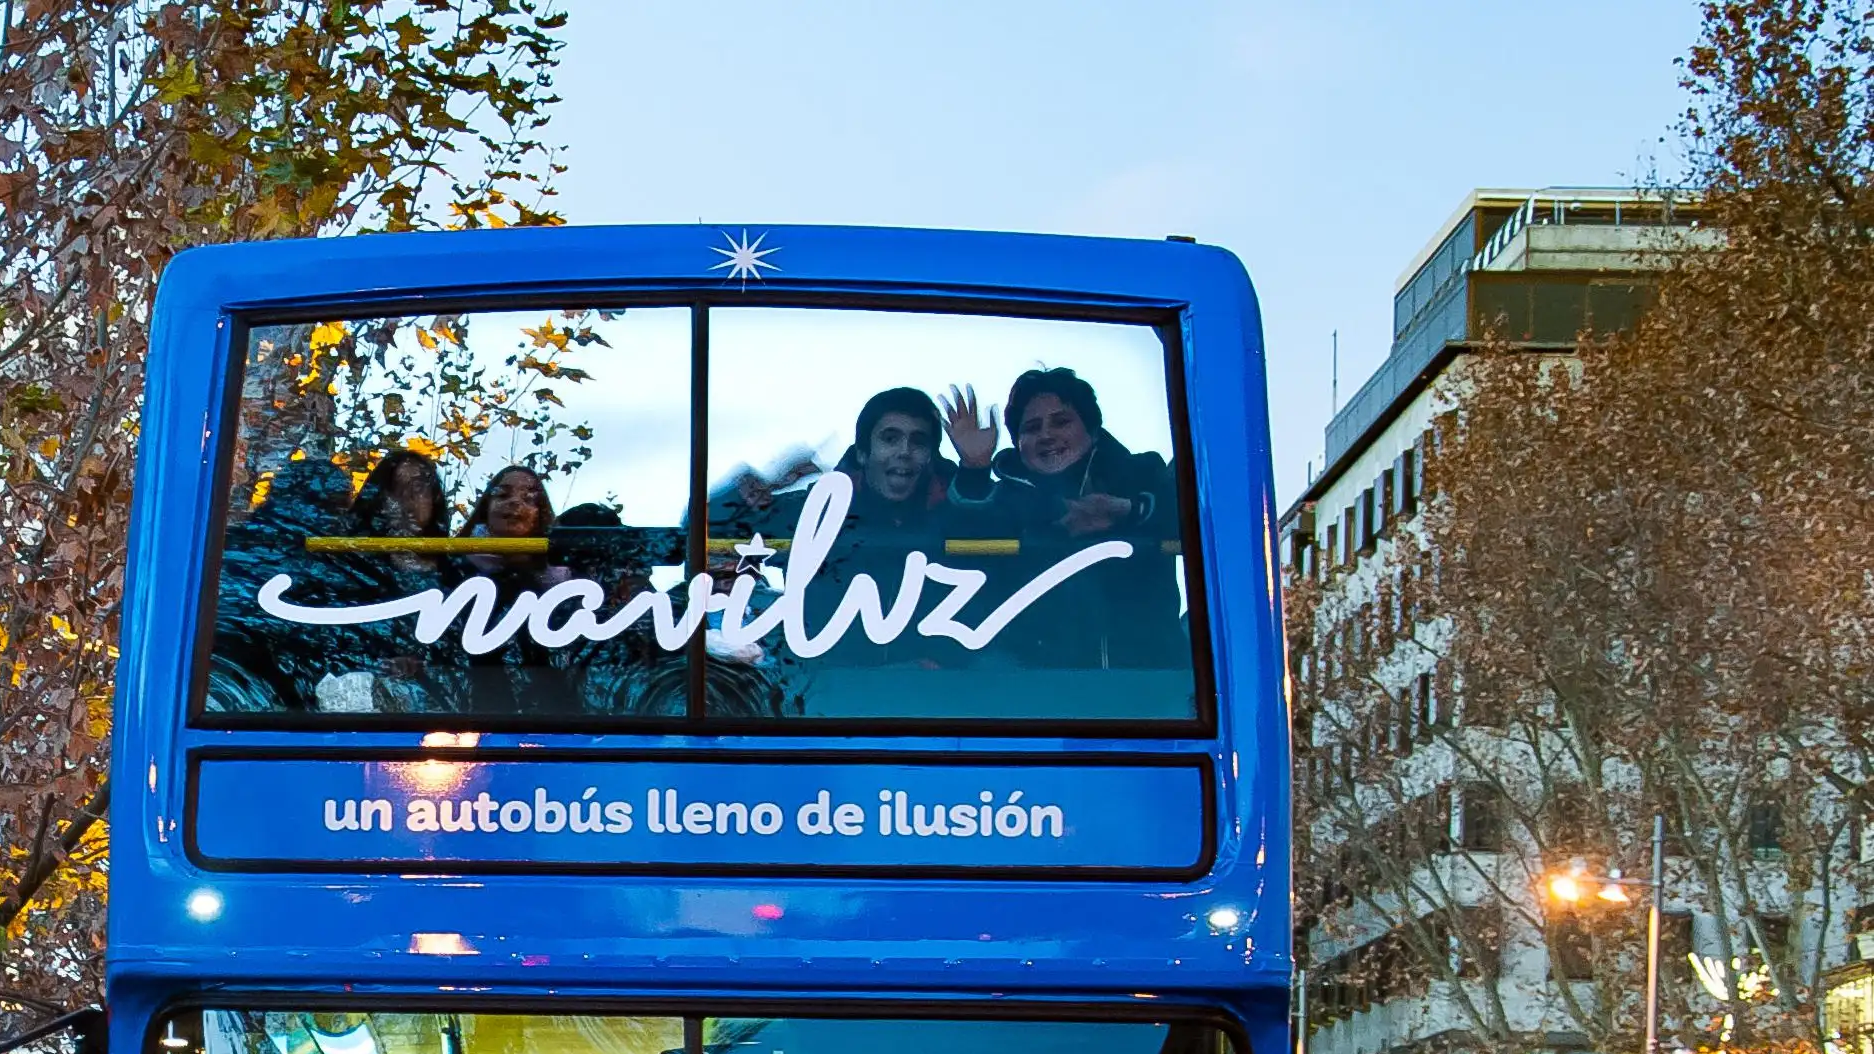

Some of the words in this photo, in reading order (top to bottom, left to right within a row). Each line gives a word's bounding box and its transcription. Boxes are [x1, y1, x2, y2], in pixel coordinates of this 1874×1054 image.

[323, 799, 390, 833] un
[404, 786, 633, 834] autobús
[646, 788, 784, 836] lleno
[796, 790, 865, 837] de
[877, 790, 1065, 839] ilusión
